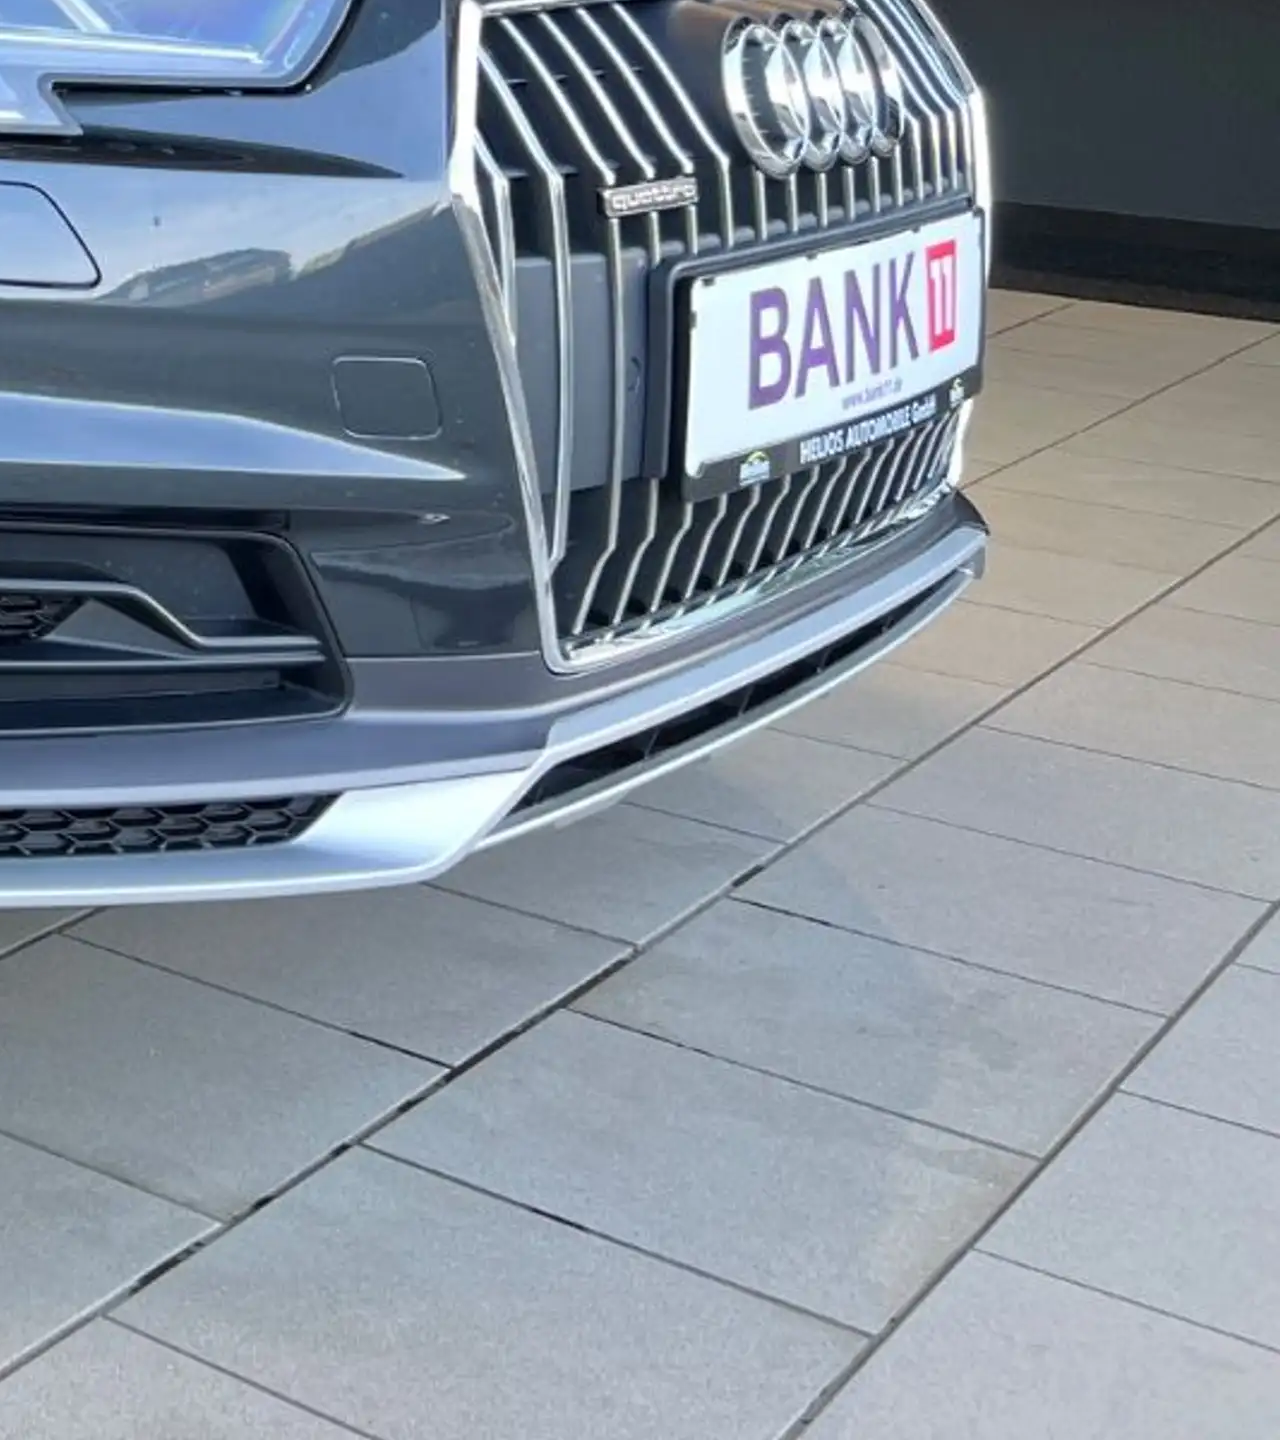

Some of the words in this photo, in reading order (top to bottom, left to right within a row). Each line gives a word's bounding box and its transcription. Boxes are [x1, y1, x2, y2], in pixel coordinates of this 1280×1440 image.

[612, 184, 696, 211] quattro
[748, 251, 919, 411] BANK
[800, 429, 844, 464] HELIOS
[845, 405, 911, 448] AUTOMOBILE
